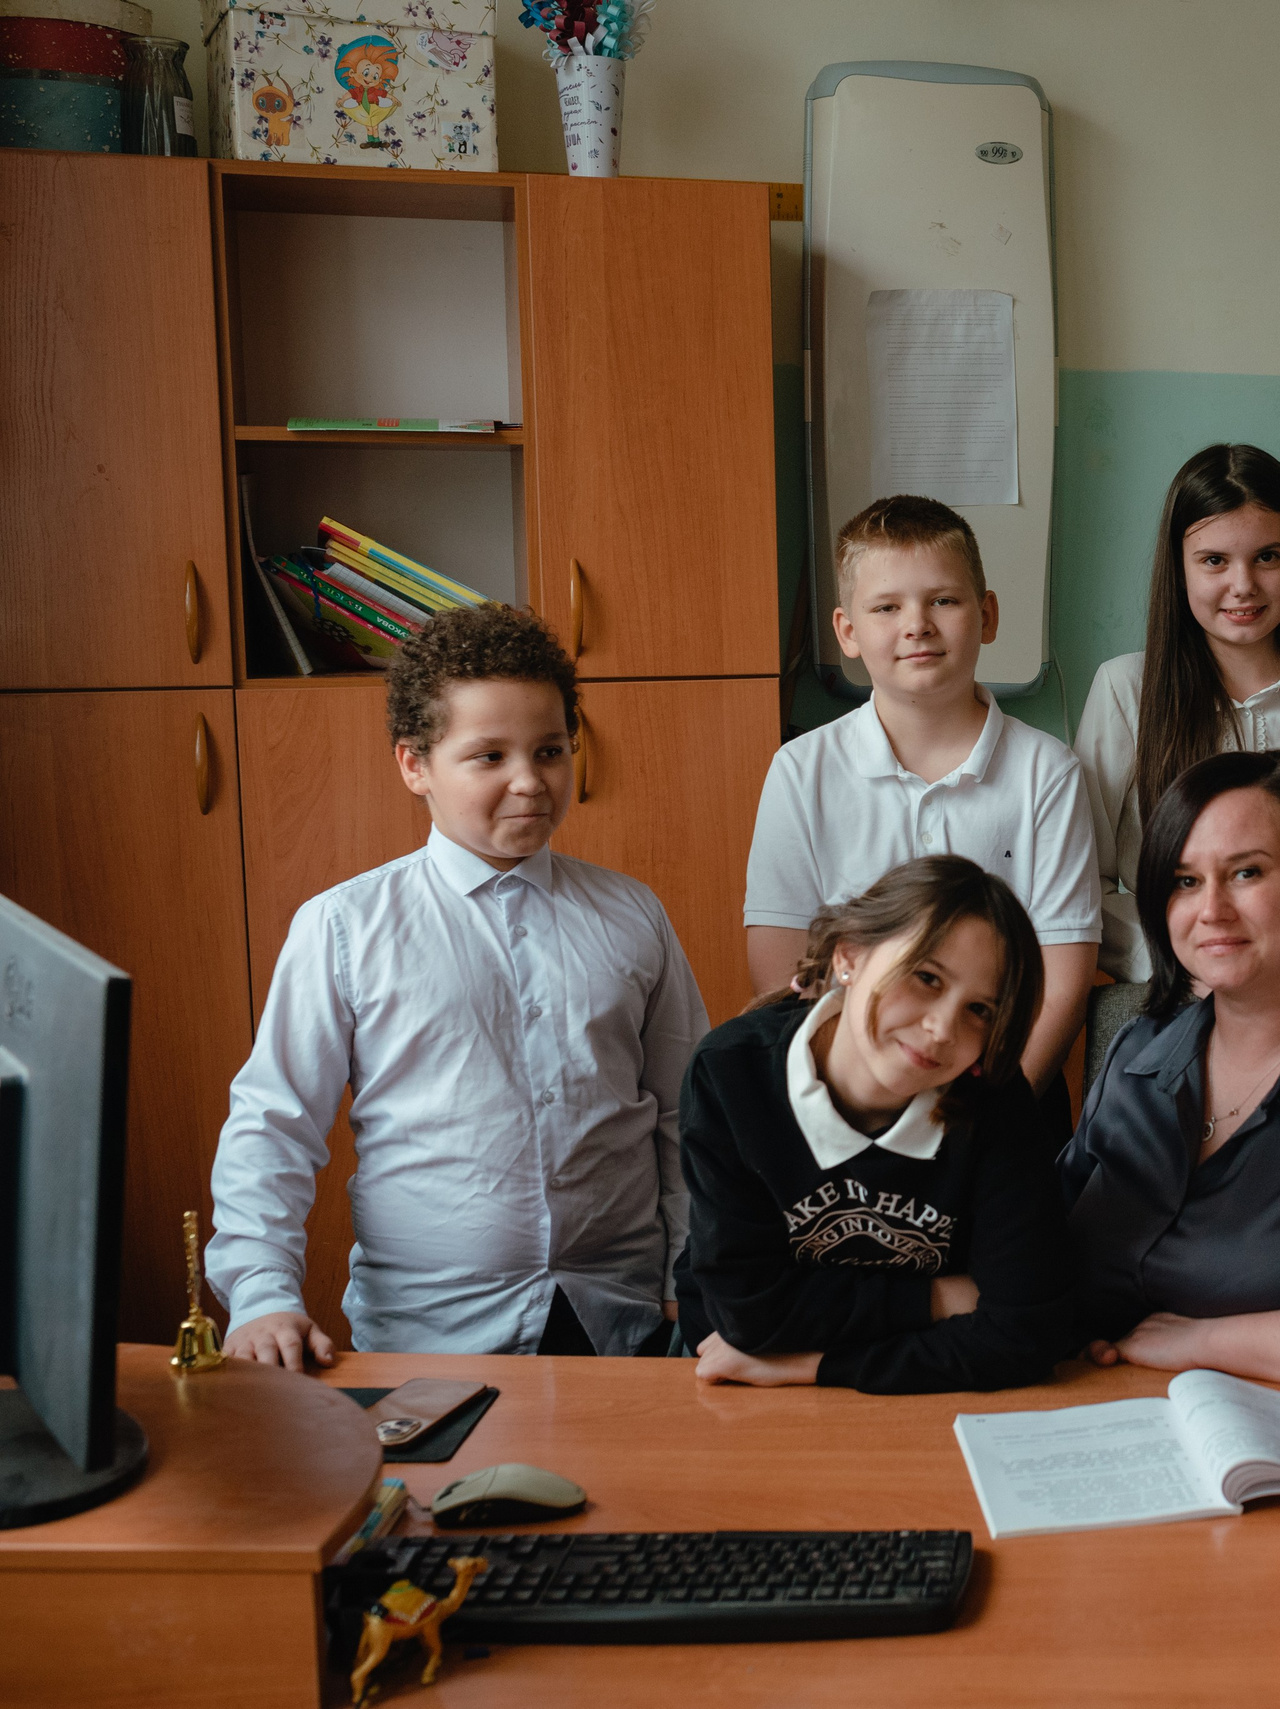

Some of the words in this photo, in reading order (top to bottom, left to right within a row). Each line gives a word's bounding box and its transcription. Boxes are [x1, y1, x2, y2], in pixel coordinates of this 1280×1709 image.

[376, 614, 410, 640] УКОВА
[783, 1181, 841, 1234] AKE
[843, 1178, 869, 1204] IT
[840, 1217, 862, 1234] IN
